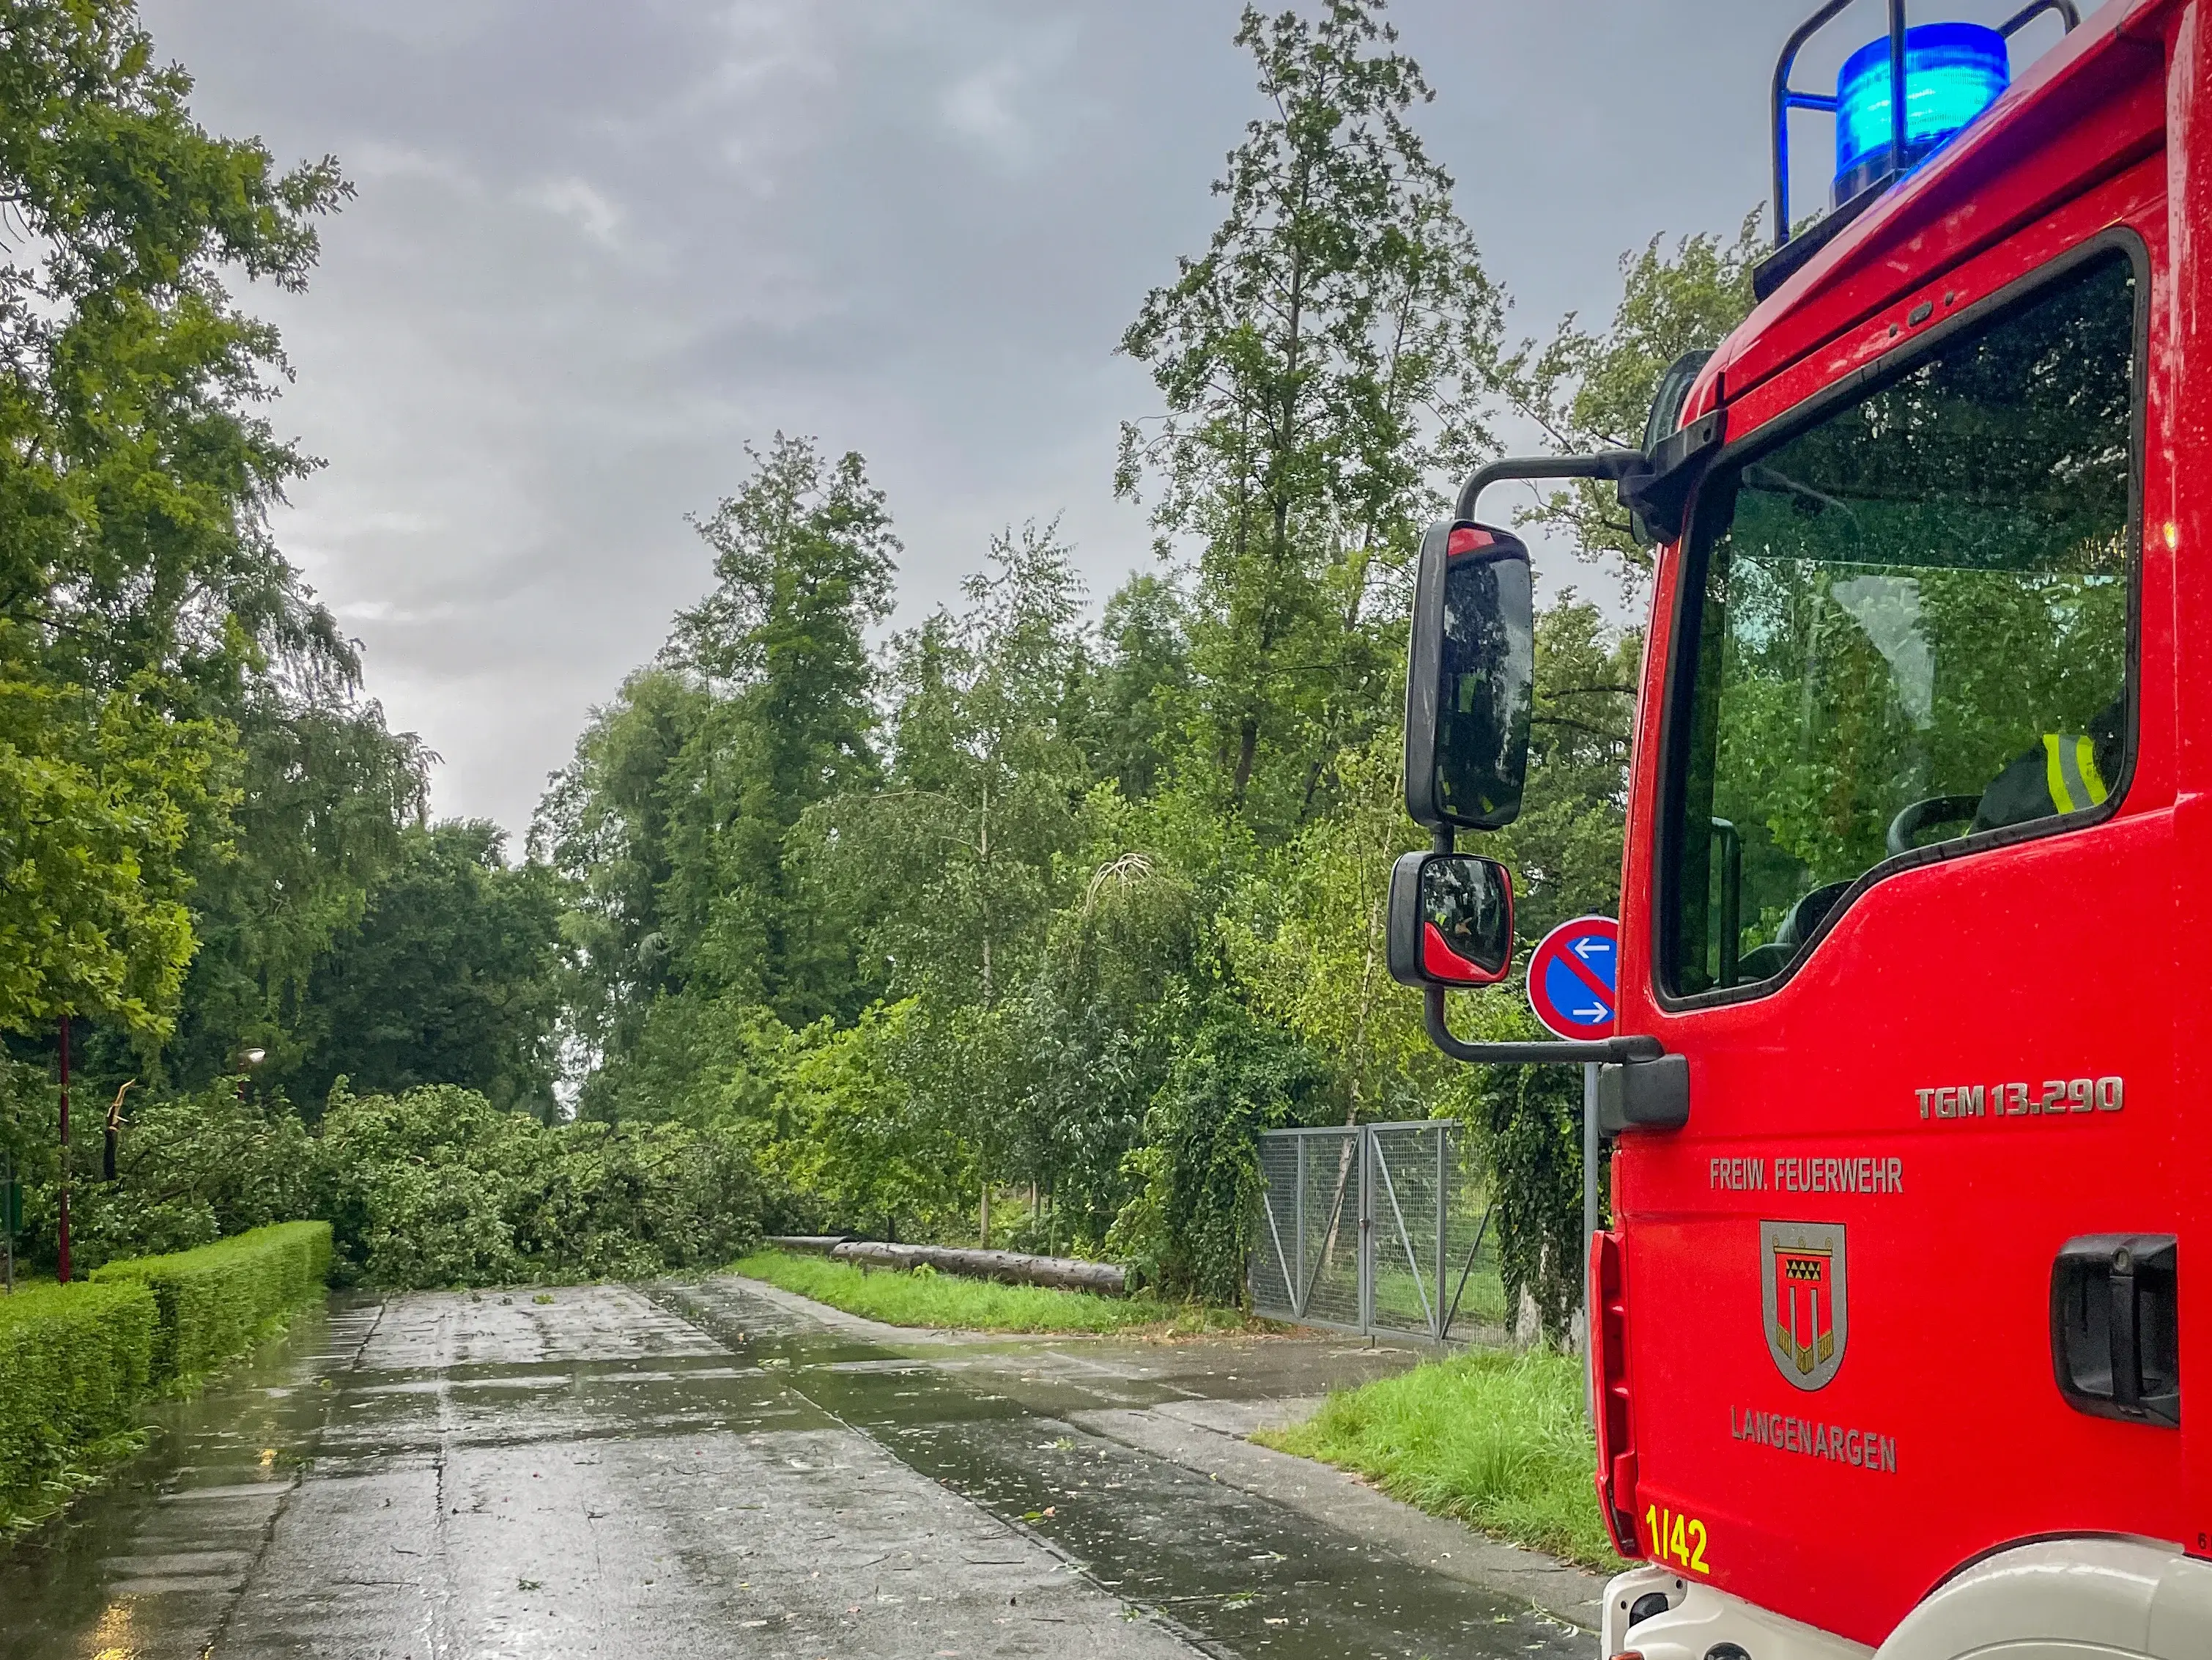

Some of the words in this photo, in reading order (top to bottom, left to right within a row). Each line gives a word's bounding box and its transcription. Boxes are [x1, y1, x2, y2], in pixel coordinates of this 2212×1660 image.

[1915, 1085, 1985, 1119] TGM
[1991, 1076, 2124, 1116] 13.290
[1710, 1158, 1768, 1190] FREIW.
[1774, 1157, 1904, 1193] FEUERWEHR
[1731, 1404, 1896, 1472] LANGENARGEN
[1646, 1503, 1710, 1575] 1/42
